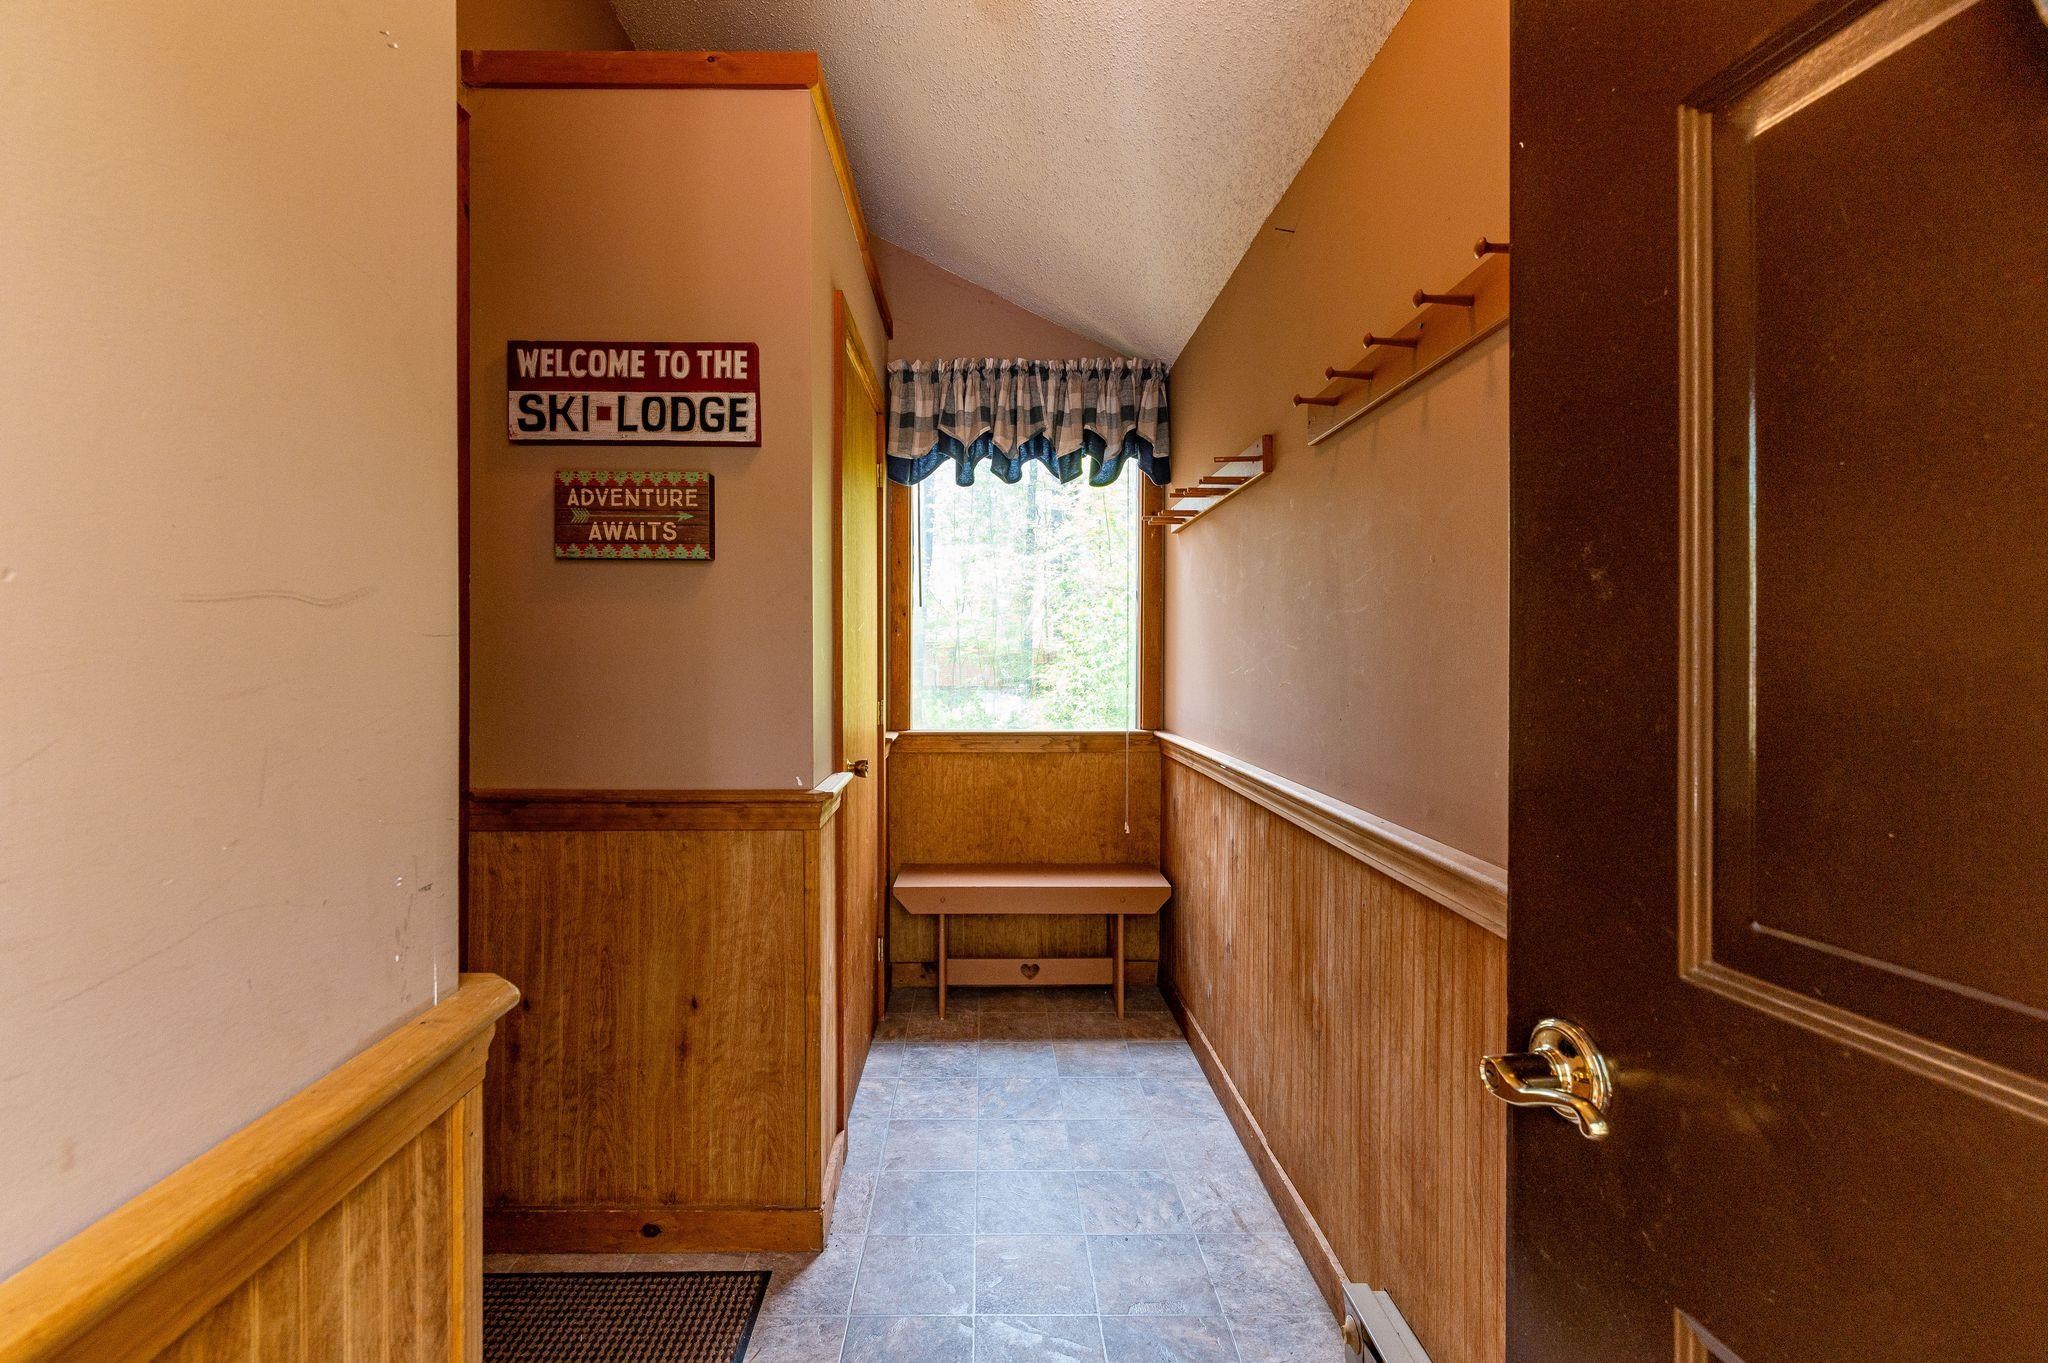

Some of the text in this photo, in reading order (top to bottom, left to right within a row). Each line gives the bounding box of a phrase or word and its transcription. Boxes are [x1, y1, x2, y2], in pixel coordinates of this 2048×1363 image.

[517, 349, 748, 379] WELCOME TO THE
[517, 394, 748, 432] SKI LODGE
[567, 488, 698, 507] ADVENTURE
[588, 521, 677, 541] AWAITS
